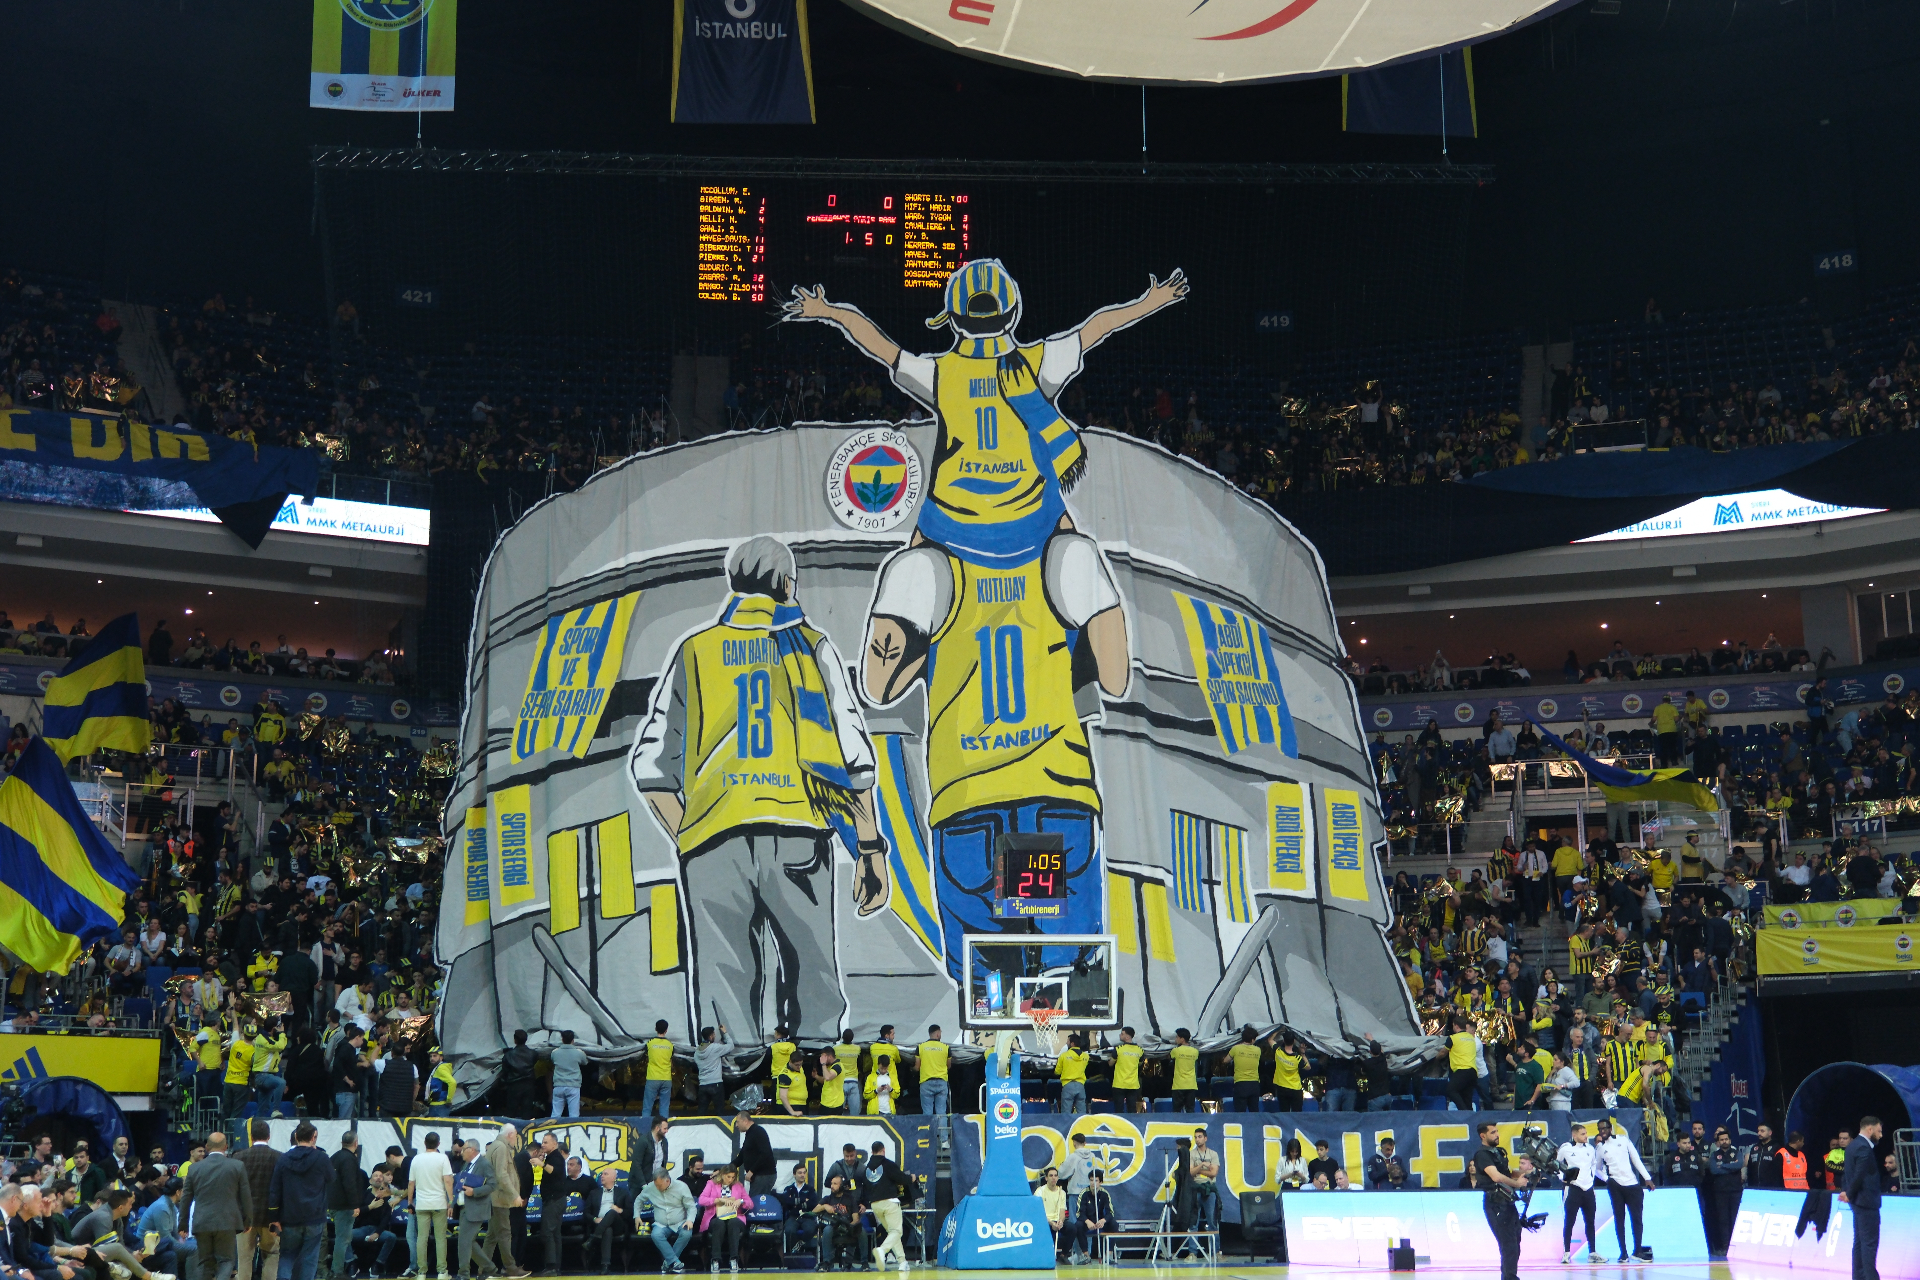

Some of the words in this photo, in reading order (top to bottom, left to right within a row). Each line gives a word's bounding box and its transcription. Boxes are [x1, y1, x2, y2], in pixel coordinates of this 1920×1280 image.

[695, 15, 788, 40] İSTANBUL
[402, 87, 442, 98] ÜLKER
[758, 206, 765, 214] 2
[827, 194, 837, 207] 0
[883, 196, 893, 210] 0
[758, 216, 765, 224] 4
[962, 214, 969, 222] 3
[755, 235, 765, 244] 11
[962, 233, 969, 241] 5
[963, 242, 969, 251] 7
[751, 254, 764, 263] 21
[755, 245, 765, 254] 13
[1819, 254, 1853, 270] 418
[752, 274, 764, 282] 32
[401, 289, 432, 304] 421
[751, 284, 764, 292] 44
[751, 293, 764, 302] 50
[1259, 315, 1290, 328] 419
[968, 375, 998, 399] MELİH
[974, 405, 999, 451] 10
[830, 432, 877, 509] FENERBAHÇE
[958, 457, 1028, 474] İSTANBUL
[1751, 509, 1783, 522] MMK
[306, 517, 338, 530] MMK
[341, 521, 405, 537] METALURJİ
[976, 575, 1027, 604] KUTLUAY
[558, 626, 602, 656] SPOR
[1217, 622, 1245, 649] ABDİ
[722, 639, 747, 666] CAN
[558, 657, 581, 687] VE
[974, 624, 1027, 725] 10
[1206, 678, 1237, 704] SPOR
[1236, 680, 1281, 706] SALONU
[551, 687, 606, 719] SARAYI
[733, 669, 773, 759] 13
[960, 723, 1052, 752] İSTANBUL
[722, 771, 797, 789] İSTANBUL
[1275, 804, 1304, 833] ABDİ
[1331, 802, 1361, 831] ABDİ
[1852, 819, 1880, 833] 117
[500, 812, 527, 850] SPOR
[466, 827, 489, 863] SPOR
[501, 849, 530, 887] SERGİ
[1028, 853, 1061, 870] 1:05
[1018, 872, 1054, 897] 24
[989, 1086, 1021, 1096] SPALDING
[994, 1125, 1019, 1135] beko
[976, 1217, 1034, 1240] beko
[1730, 1210, 1799, 1248] EVER
